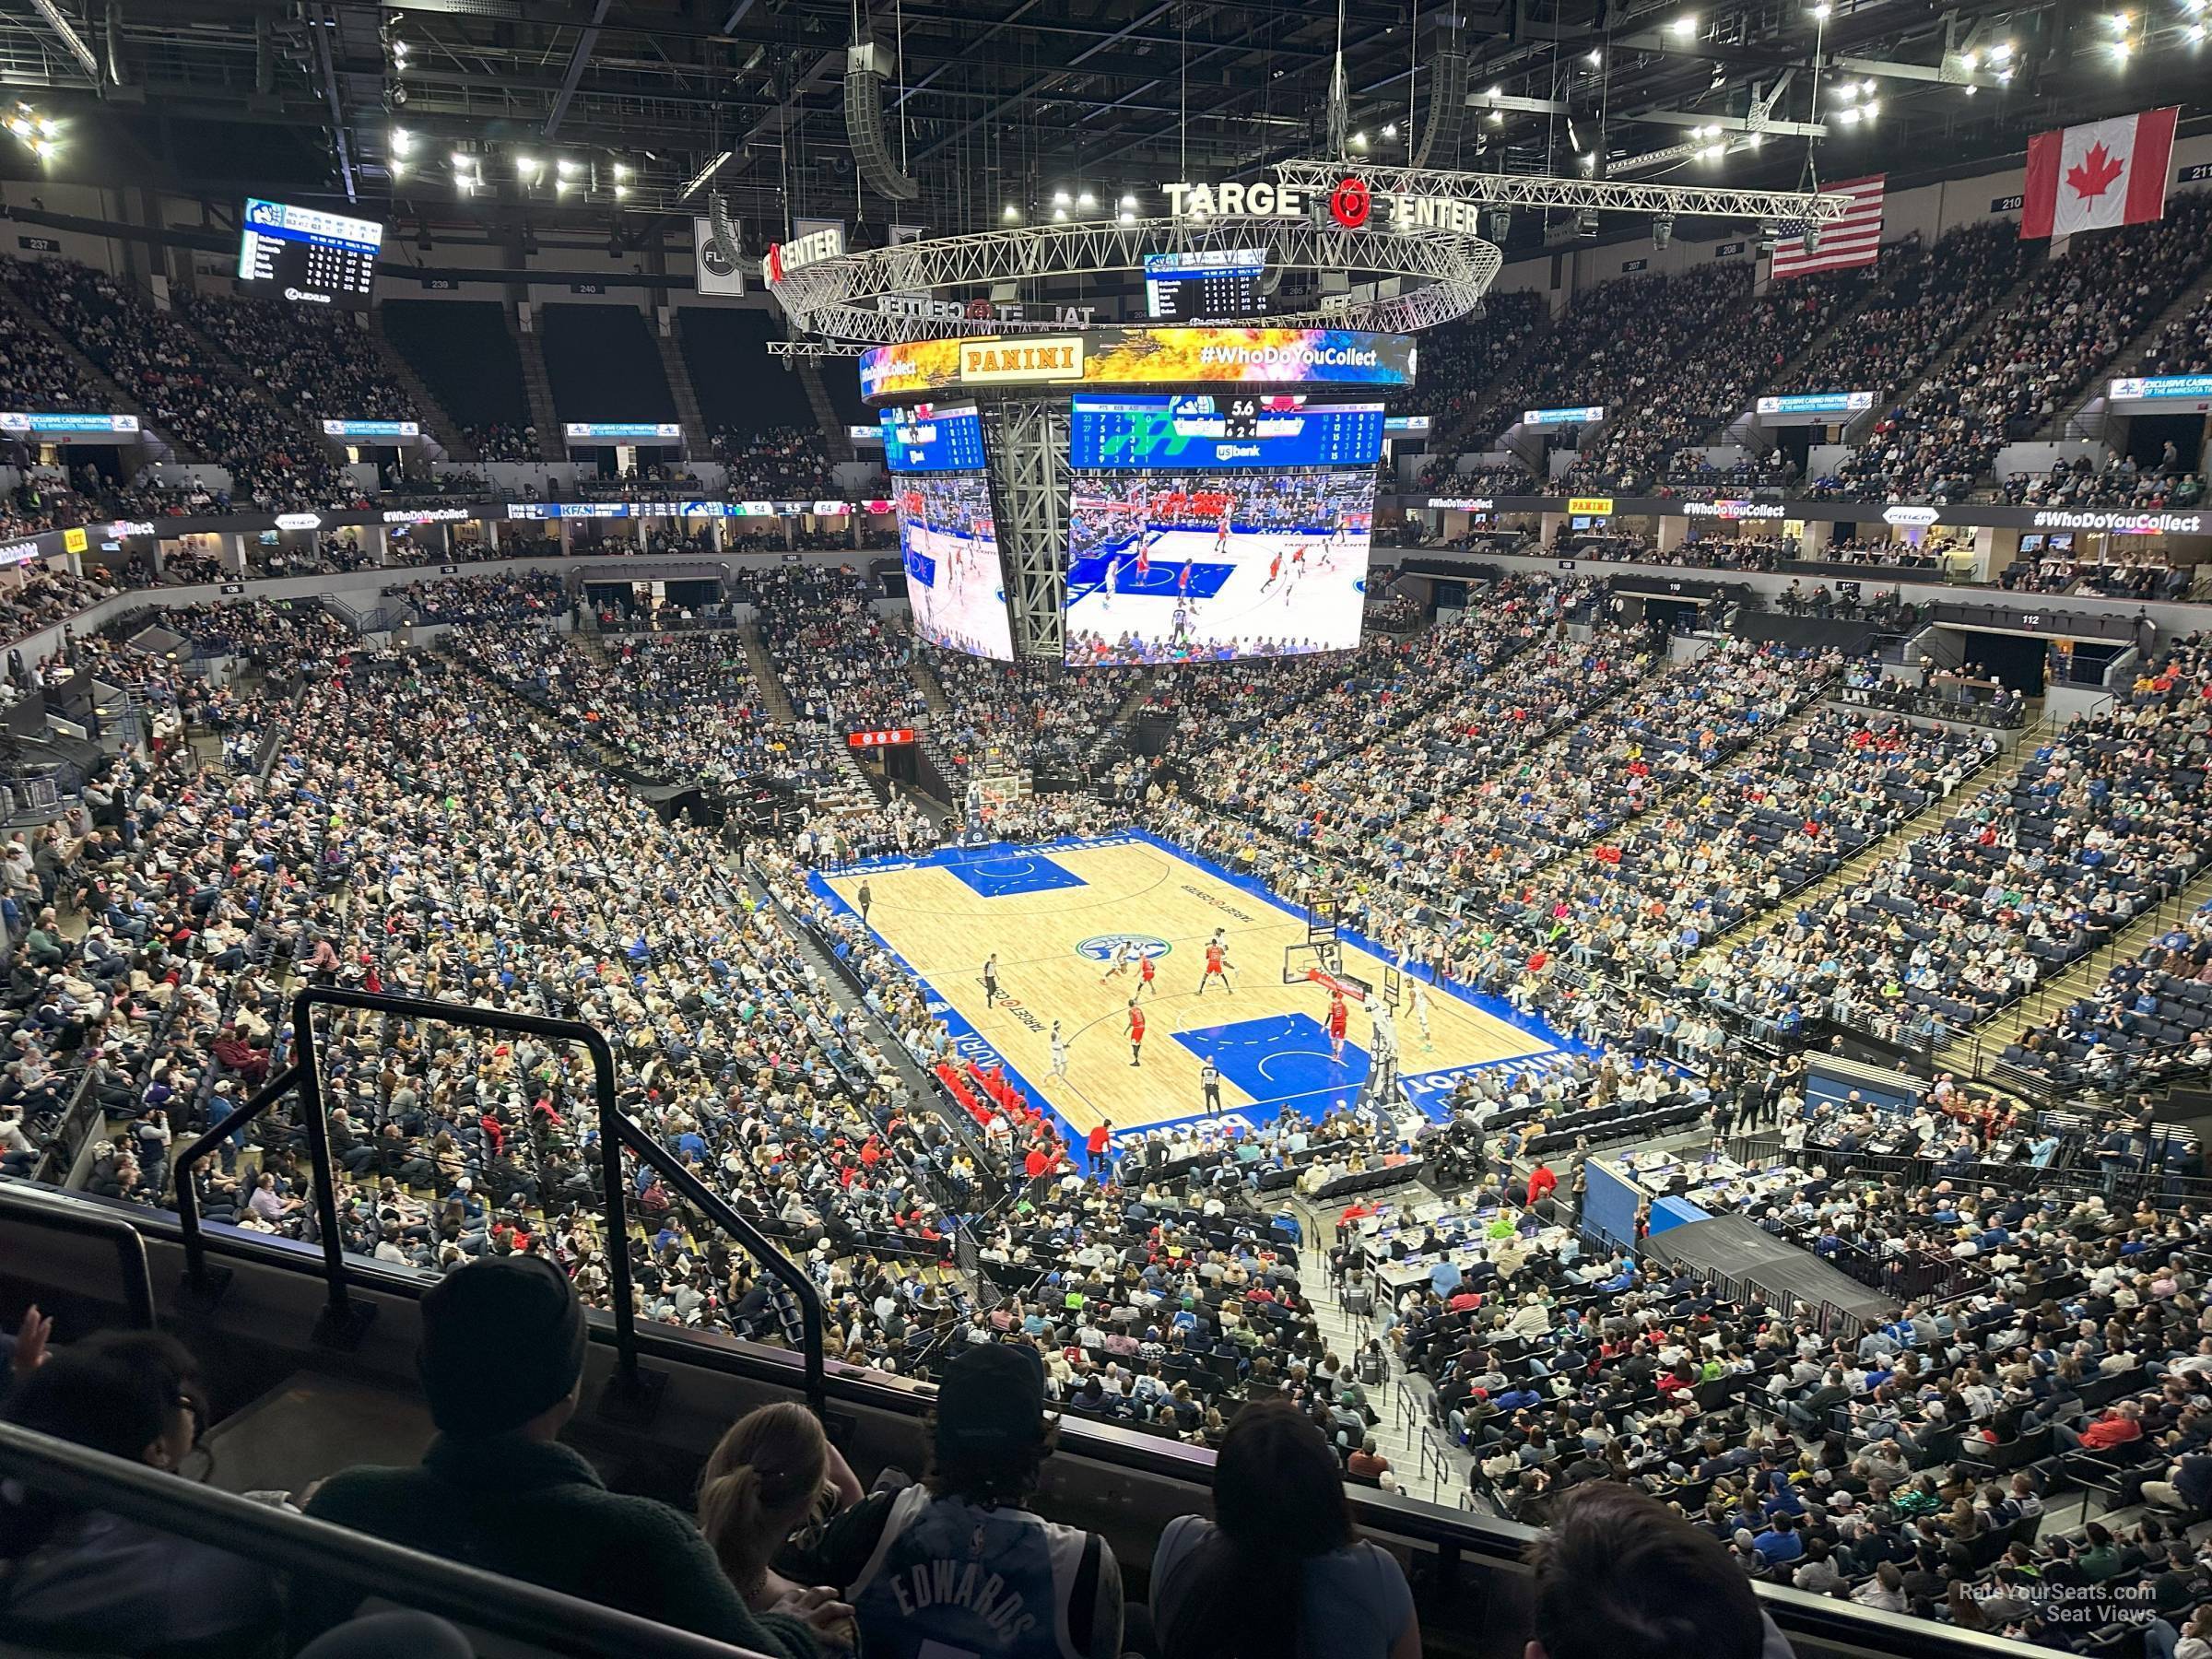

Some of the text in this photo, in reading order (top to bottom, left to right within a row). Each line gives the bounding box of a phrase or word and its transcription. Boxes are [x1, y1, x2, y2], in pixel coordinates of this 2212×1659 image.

[1163, 182, 1307, 216] TARGE
[2003, 197, 2021, 209] 210
[30, 240, 48, 250] 237
[705, 251, 726, 262] FL
[780, 229, 842, 273] CENTER
[580, 285, 596, 293] 240
[968, 347, 1074, 372] PANINI
[1200, 346, 1377, 367] #WhoDoYouCollect
[2145, 379, 2185, 388] EXCLUSIVE
[1231, 400, 1254, 416] 5.6
[1335, 414, 1340, 422] 3
[1226, 427, 1255, 438] 6 2 4
[1232, 445, 1261, 457] bank
[1084, 455, 1148, 464] 5 9 3 4 1
[754, 505, 765, 513] 54
[785, 502, 802, 512] 5.5
[820, 504, 832, 512] 64
[1429, 498, 1493, 509] #WhoDoYouCollect
[1571, 501, 1610, 512] PANINI
[562, 505, 593, 515] KFAN
[1683, 502, 1785, 518] #WhoDoYouCollect
[382, 509, 469, 523] #WhoDoYouCollect
[2034, 511, 2201, 533] #WhoDoYouCollect
[1669, 582, 1681, 591] 110
[2022, 615, 2040, 625] 112
[1013, 837, 1145, 857] MINNESOTA
[1181, 885, 1255, 923] TARGET CENTER
[1008, 1007, 1047, 1033] TARGET
[957, 1032, 1006, 1068] AURA
[889, 1559, 1037, 1644] EDWARDS
